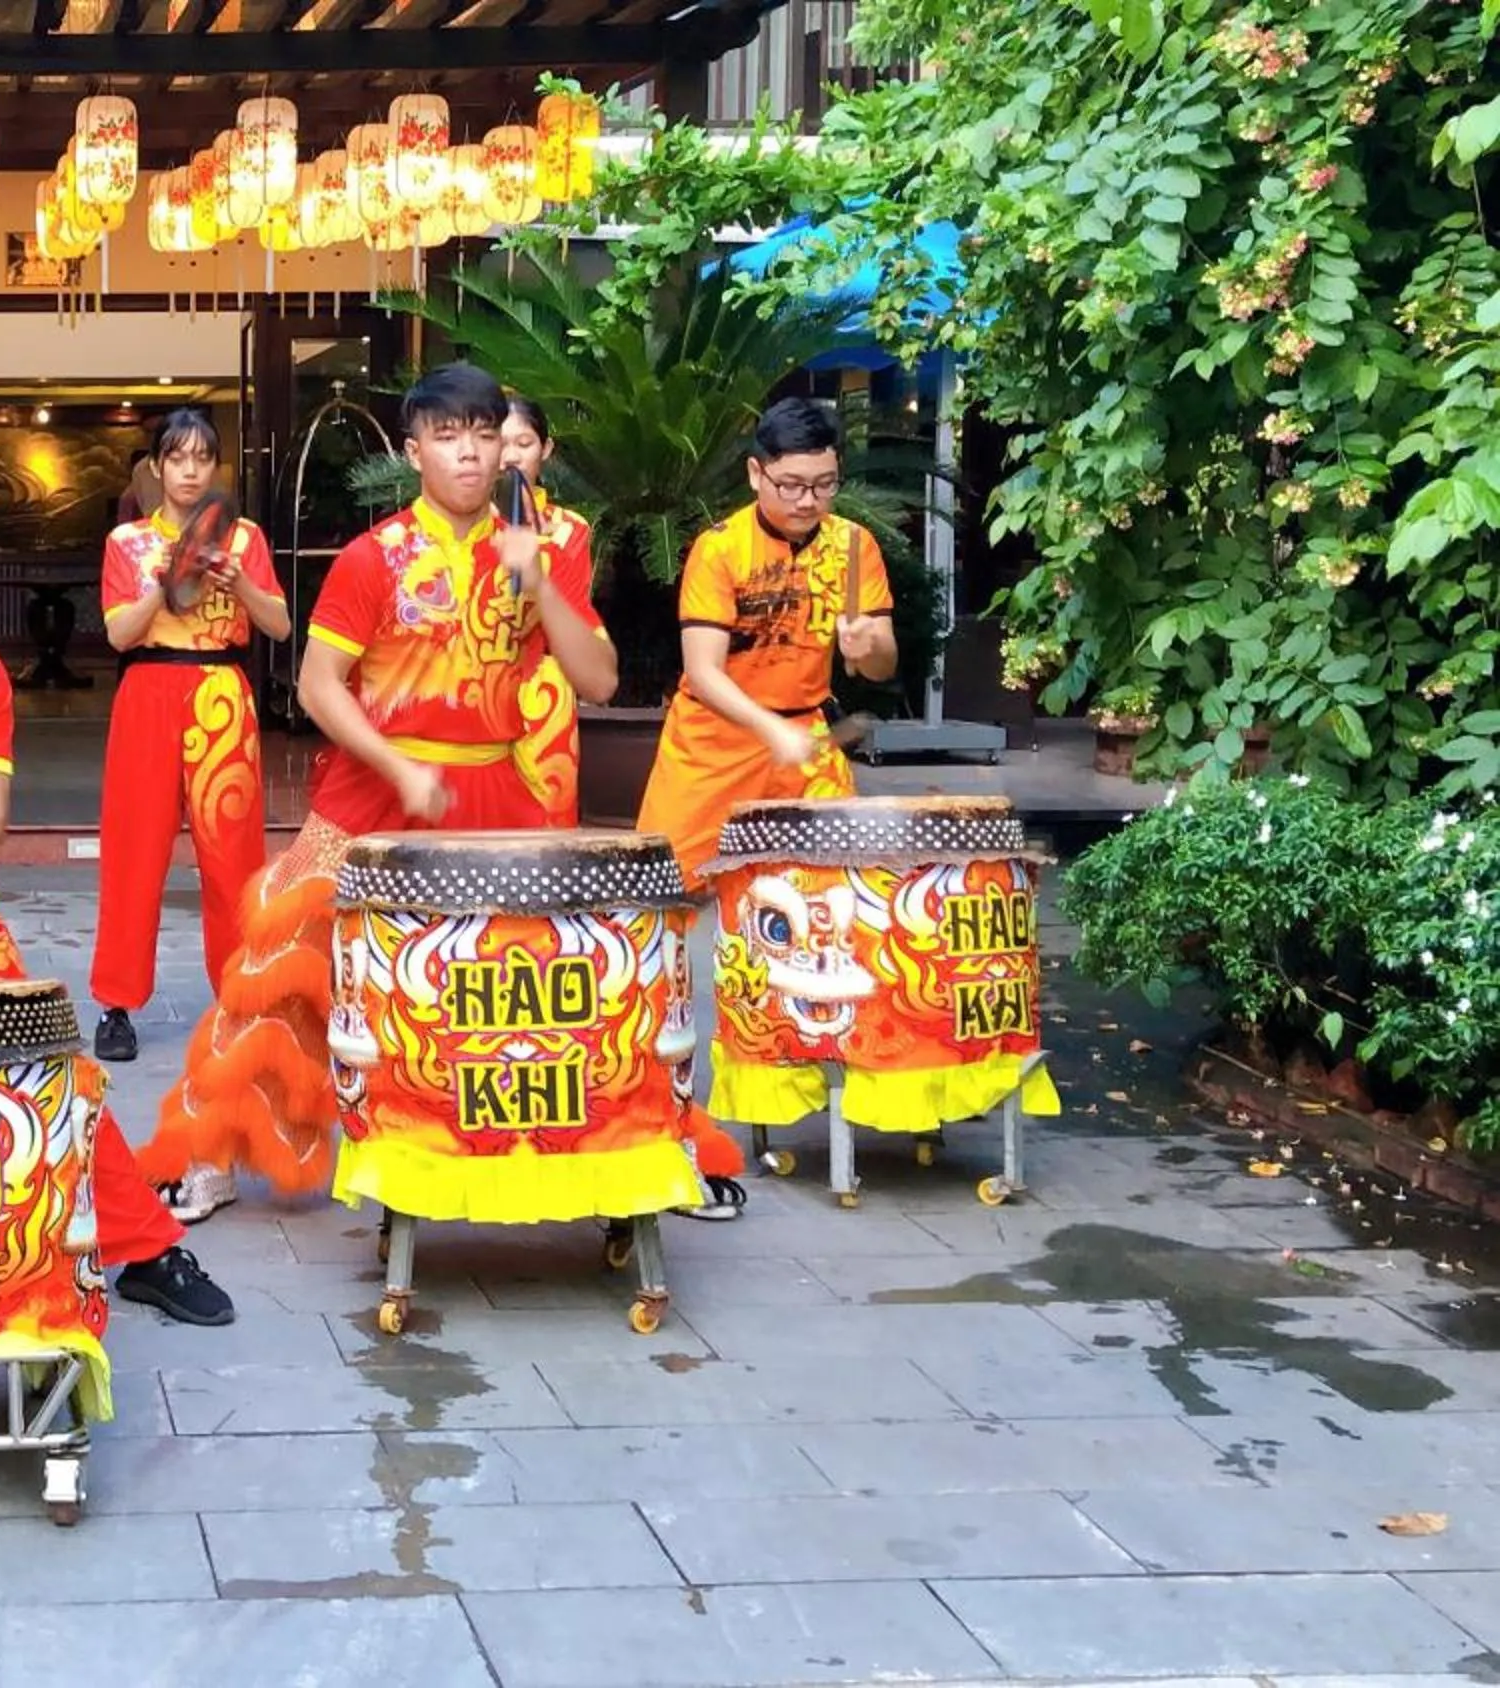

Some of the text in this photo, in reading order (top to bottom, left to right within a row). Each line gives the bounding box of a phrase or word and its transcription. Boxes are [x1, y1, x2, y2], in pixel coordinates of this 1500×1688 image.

[943, 883, 1029, 951] HÀO
[445, 949, 593, 1027] HÀO
[958, 967, 1031, 1037] KHÍ
[458, 1050, 583, 1126] KHÍ
